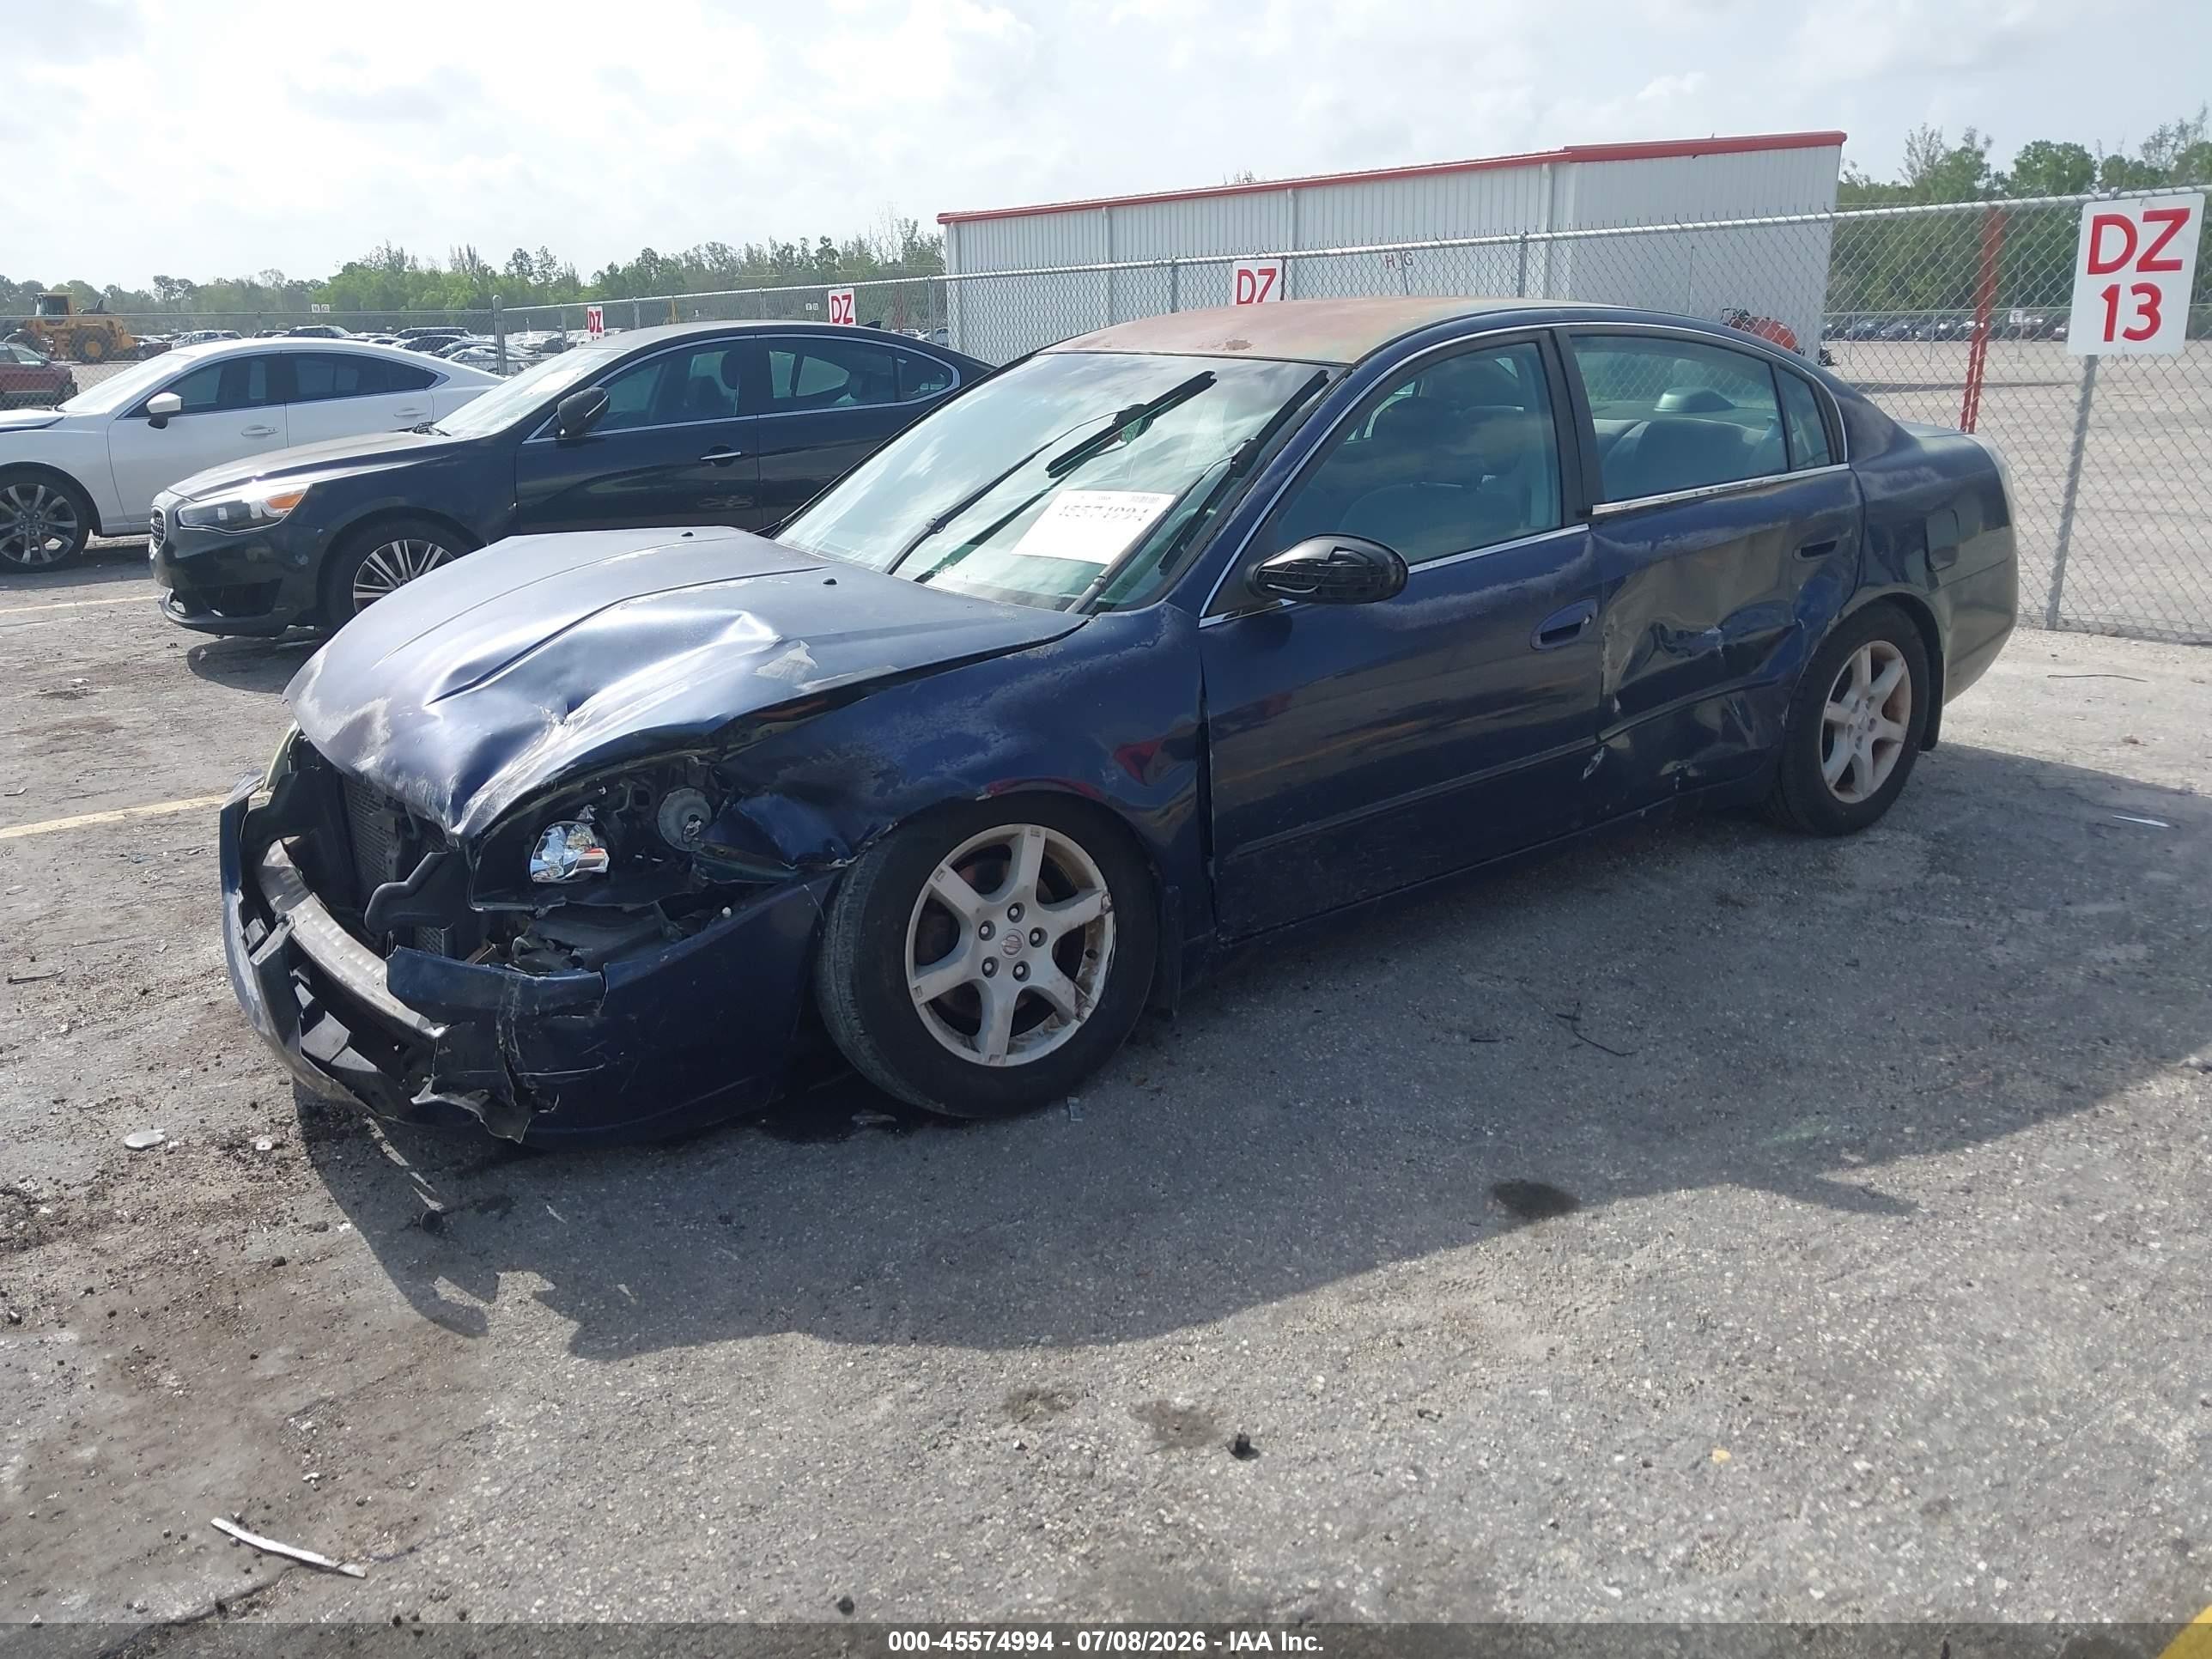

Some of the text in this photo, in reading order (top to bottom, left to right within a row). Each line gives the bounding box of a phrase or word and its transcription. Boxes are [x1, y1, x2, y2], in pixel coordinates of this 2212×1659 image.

[2087, 208, 2191, 275] DZ
[589, 311, 602, 332] DZ
[831, 295, 853, 324] DZ
[2100, 282, 2162, 342] 13
